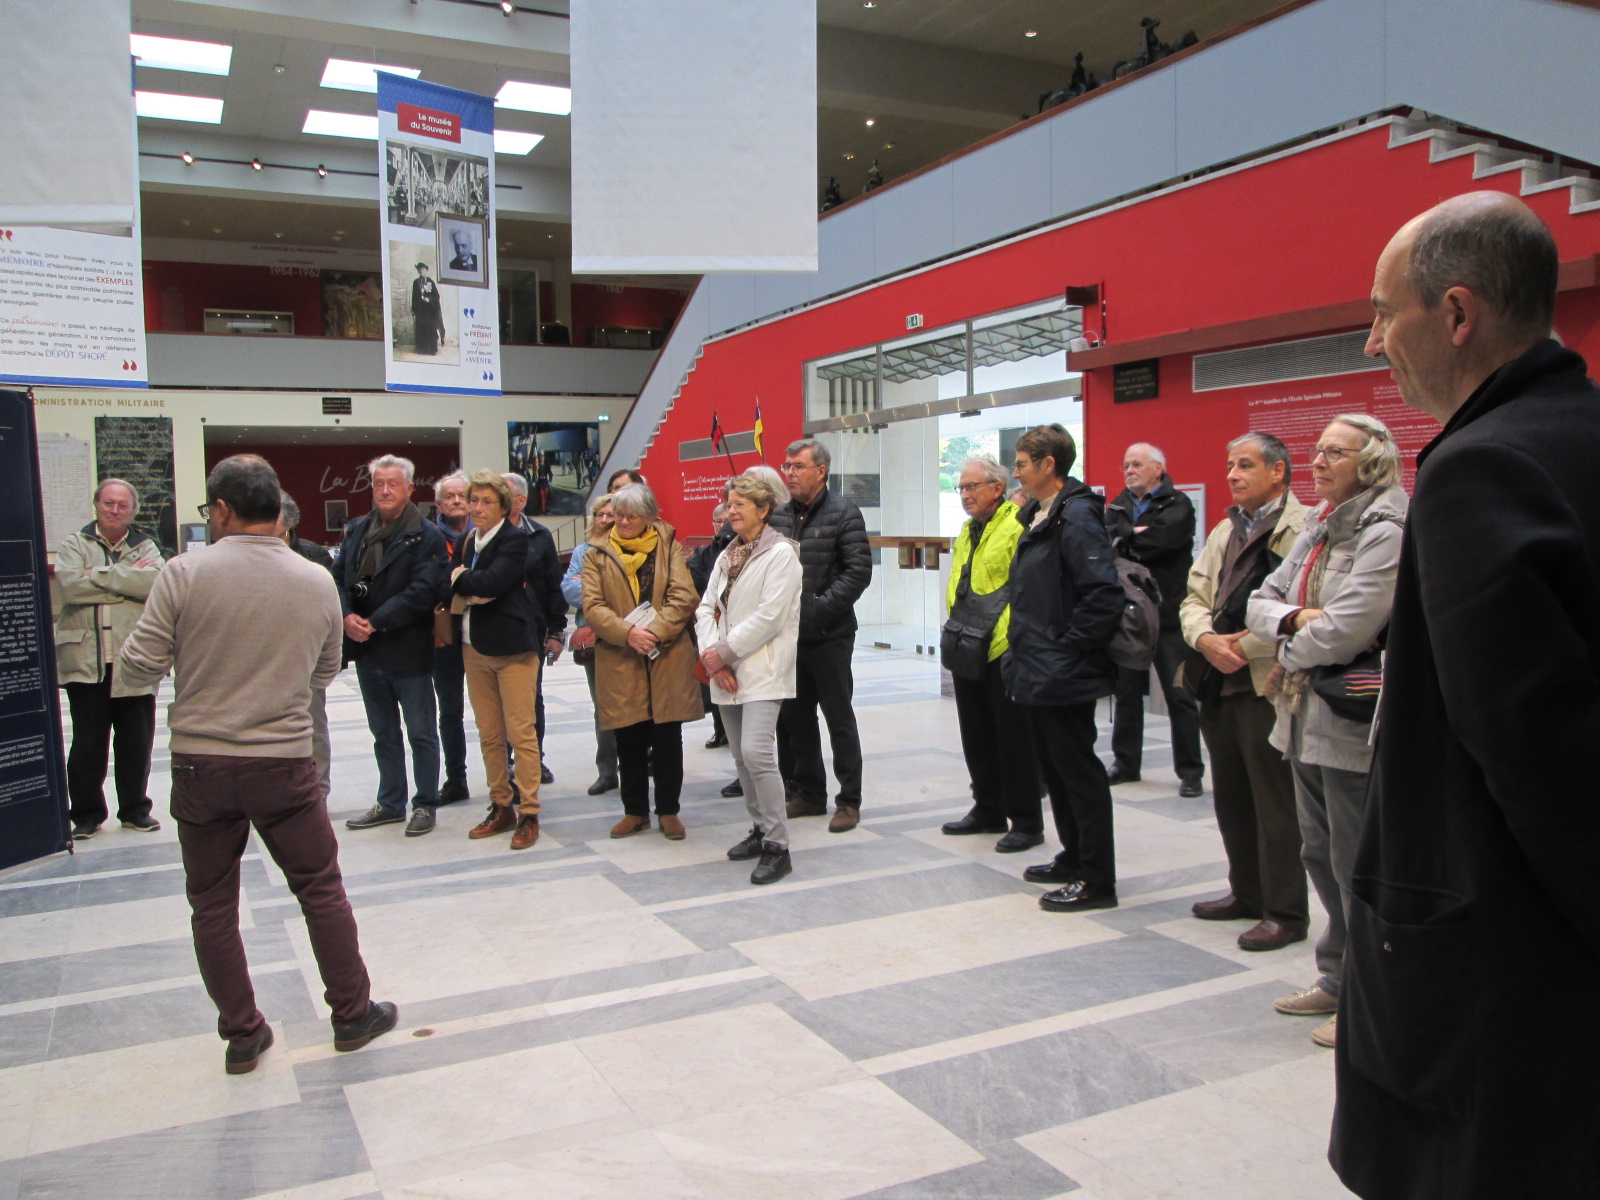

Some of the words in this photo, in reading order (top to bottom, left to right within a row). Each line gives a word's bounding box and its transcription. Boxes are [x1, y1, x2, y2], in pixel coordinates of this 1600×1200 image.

[418, 112, 427, 120] Le
[428, 116, 452, 126] musée
[410, 121, 420, 130] du
[422, 123, 452, 136] Souvenir
[96, 276, 134, 286] EXEMPLES
[470, 330, 492, 339] PRÉSENT
[33, 398, 112, 407] DMINISTRATION
[320, 466, 348, 493] La
